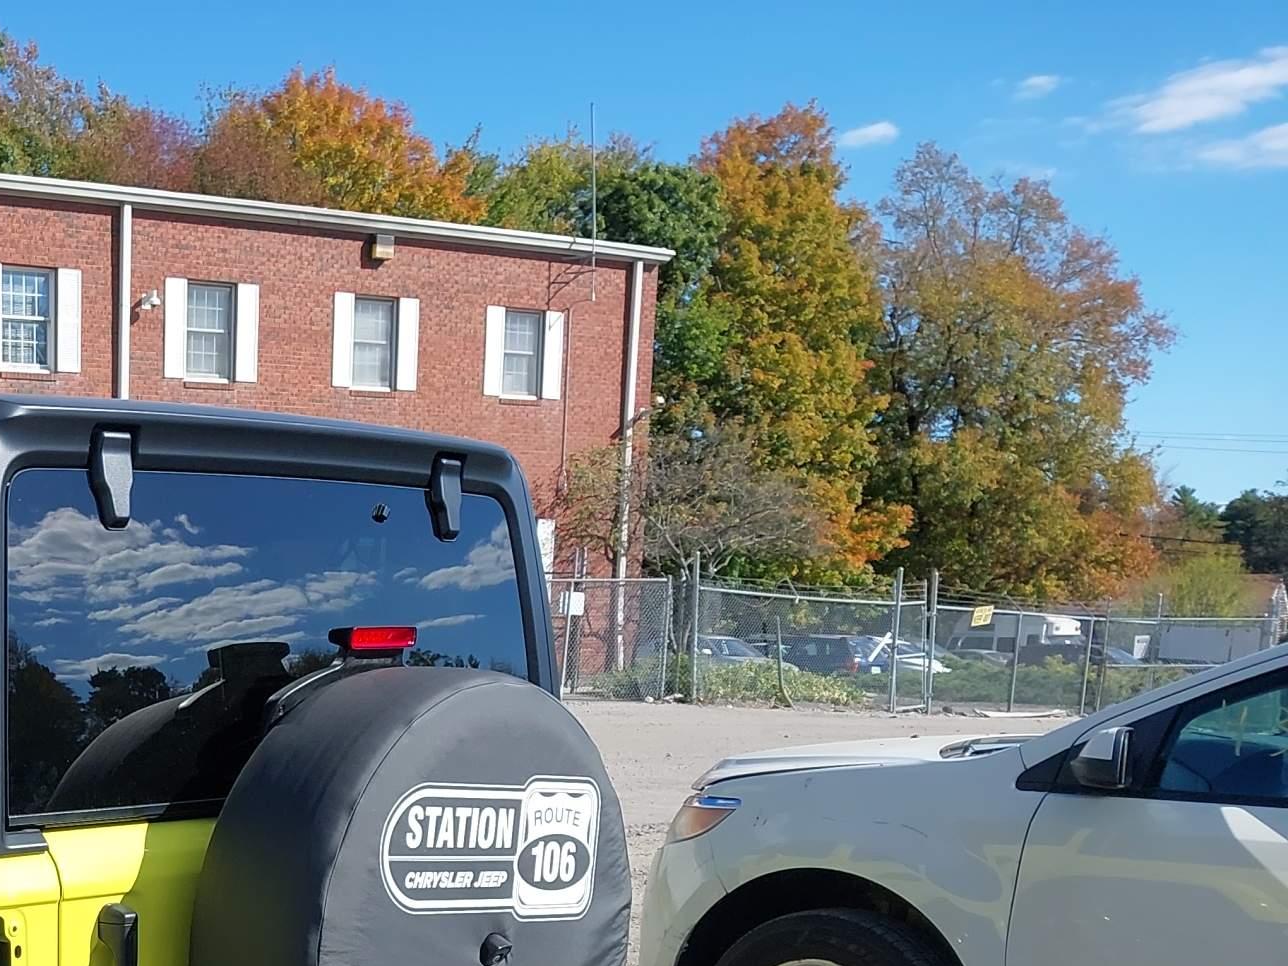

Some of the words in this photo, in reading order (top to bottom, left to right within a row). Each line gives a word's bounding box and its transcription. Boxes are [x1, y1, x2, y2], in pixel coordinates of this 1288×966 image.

[405, 804, 516, 850] STATION
[533, 807, 582, 827] ROUTE
[530, 840, 578, 883] 106
[404, 871, 474, 889] CHRYSLER
[473, 870, 509, 889] JEEP
